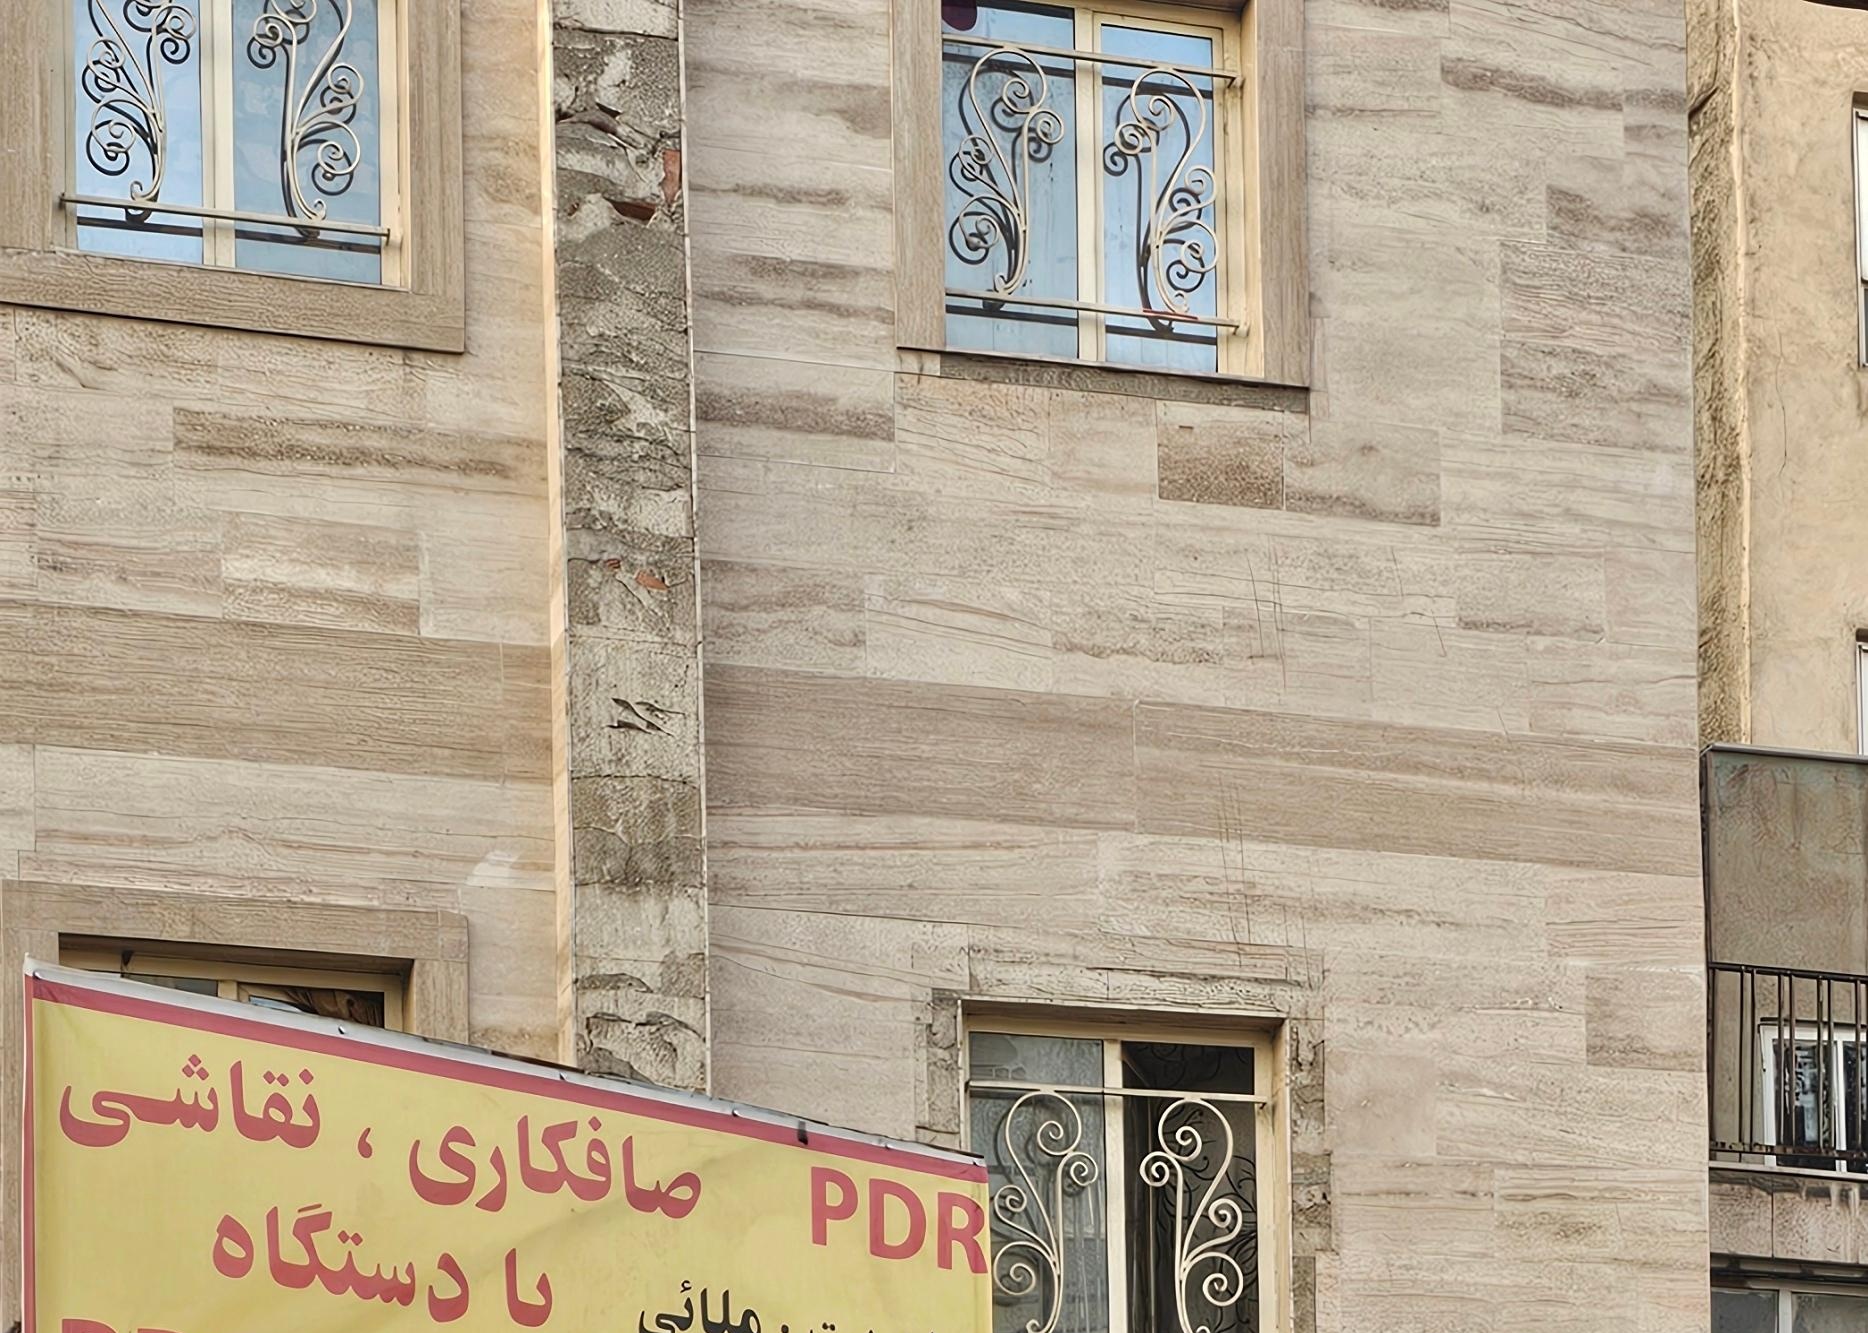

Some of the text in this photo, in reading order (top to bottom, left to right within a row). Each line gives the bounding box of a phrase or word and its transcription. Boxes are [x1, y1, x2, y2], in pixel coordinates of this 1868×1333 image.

[59, 1053, 321, 1148] نقاشی
[409, 1115, 702, 1219] صافکاری
[810, 1166, 988, 1274] PDR
[212, 1204, 470, 1322] دستگاه
